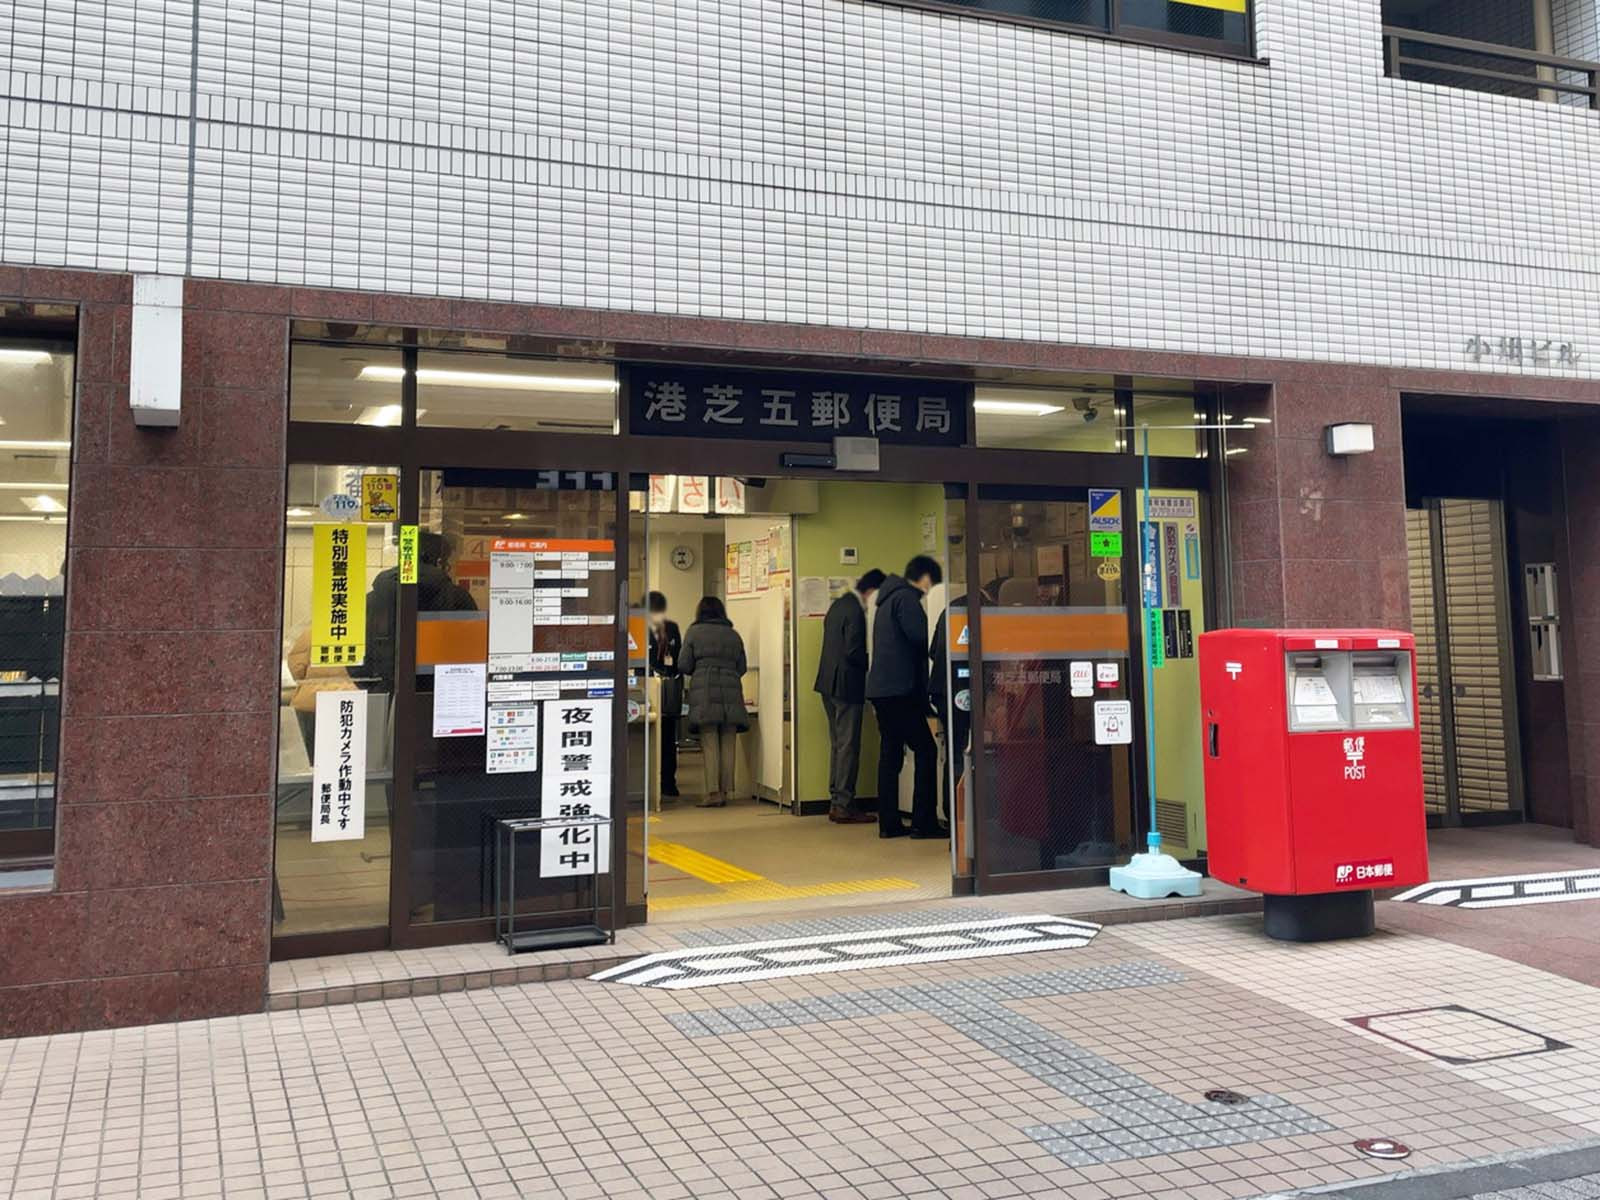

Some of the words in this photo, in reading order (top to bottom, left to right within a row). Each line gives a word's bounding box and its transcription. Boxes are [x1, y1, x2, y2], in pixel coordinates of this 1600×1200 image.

[643, 381, 951, 434] 港芝五郵便局
[1091, 517, 1120, 525] ALSOK
[330, 529, 349, 641] 特別警戒実施中
[337, 700, 354, 830] 防犯カメラ作動中です
[1343, 736, 1366, 753] 郵便
[559, 707, 593, 869] 夜間警戒強化中
[1344, 766, 1366, 780] POST
[320, 783, 333, 825] 郵便局長
[1356, 863, 1393, 879] 日本郵便
